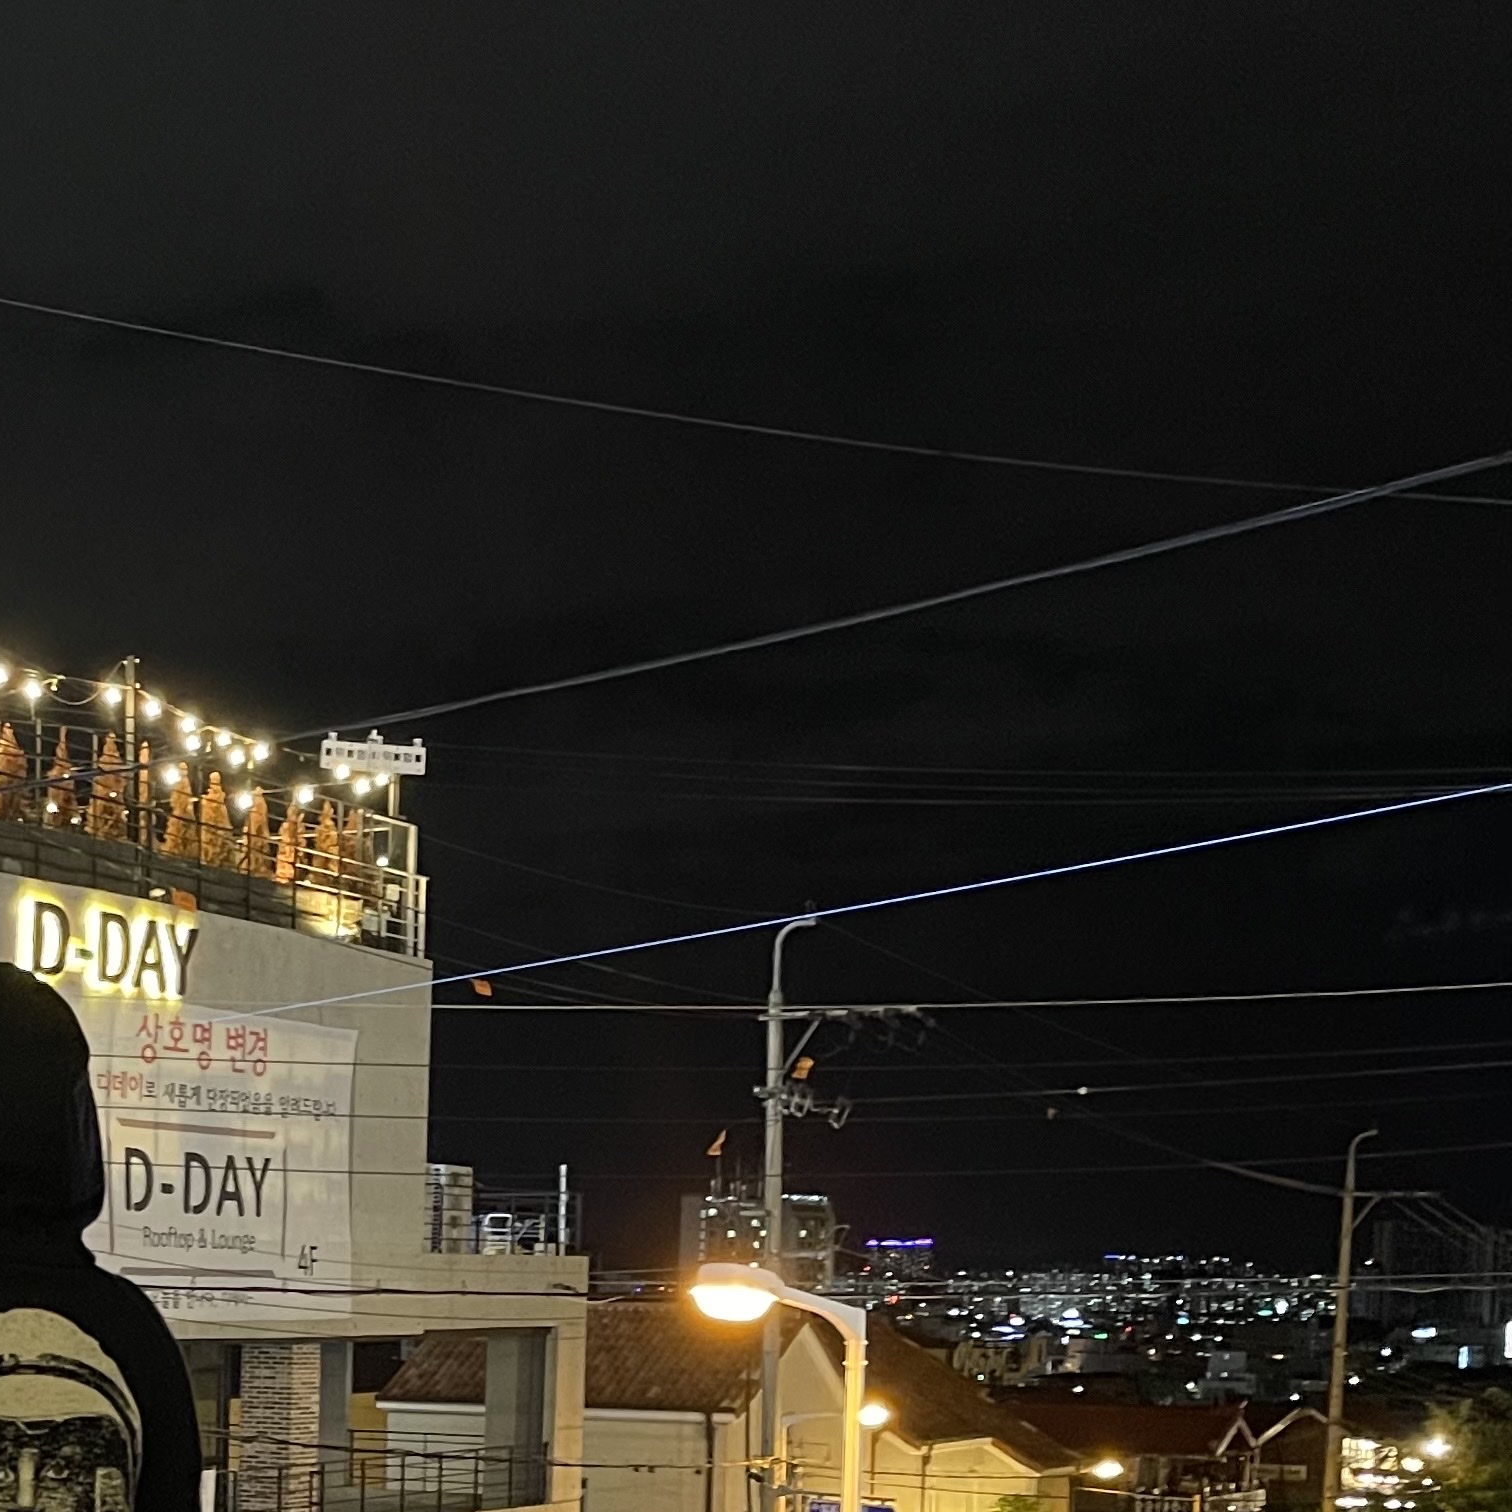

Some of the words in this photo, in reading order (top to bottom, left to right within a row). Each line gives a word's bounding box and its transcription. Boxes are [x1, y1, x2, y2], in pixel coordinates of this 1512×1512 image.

[32, 900, 200, 996] D-DAY
[136, 1013, 213, 1071] 상호명
[226, 1024, 268, 1077] 변경
[96, 1070, 157, 1101] 디데이로
[162, 1082, 202, 1109] 새롭게
[123, 1147, 272, 1218] D-DAY
[142, 1226, 195, 1252] Rooftop
[197, 1228, 207, 1249] &
[211, 1229, 257, 1254] Lounge
[297, 1244, 319, 1276] 4F
